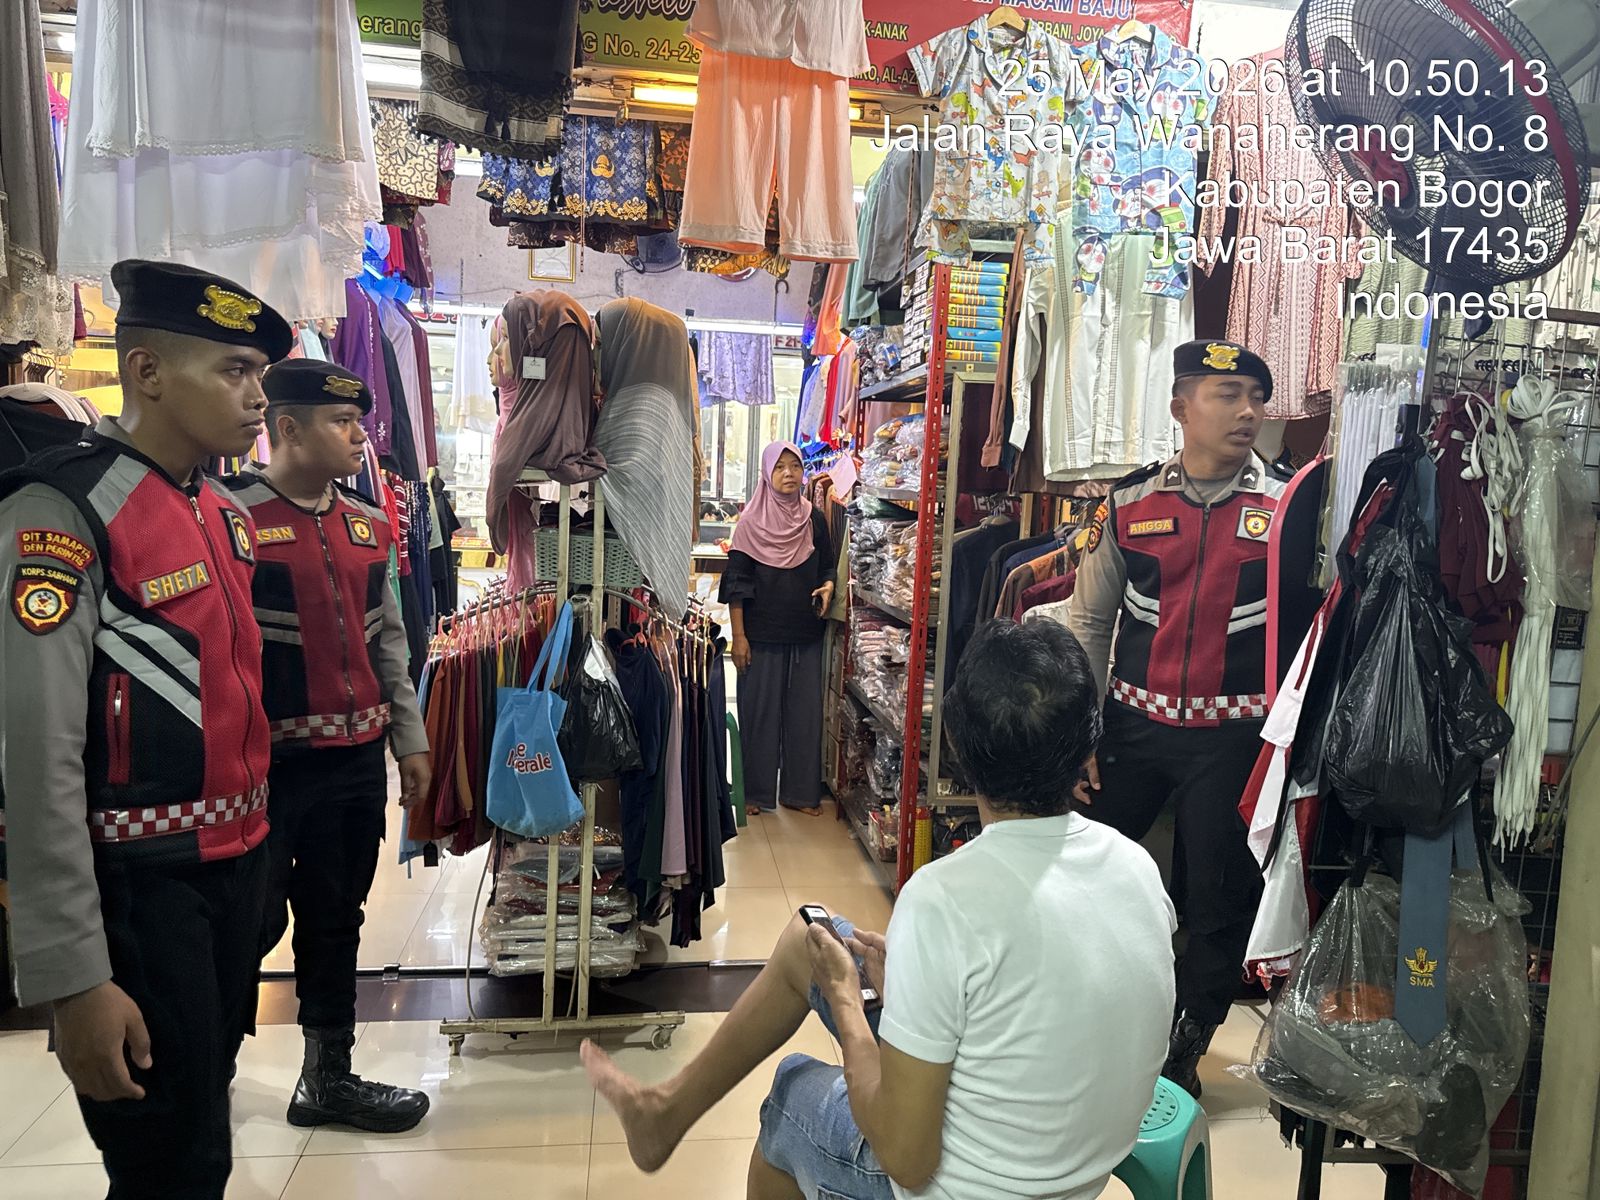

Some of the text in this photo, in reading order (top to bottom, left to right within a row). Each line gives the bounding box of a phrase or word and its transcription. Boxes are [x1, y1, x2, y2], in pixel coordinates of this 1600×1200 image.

[1077, 0, 1131, 19] BAJU
[357, 15, 422, 41] erang
[604, 33, 640, 58] No.
[645, 38, 702, 64] 24-25
[882, 67, 919, 86] AL-AZ
[22, 532, 41, 542] DIT
[23, 543, 43, 552] DEN
[147, 563, 207, 600] SHETA
[1409, 976, 1435, 988] SMA
